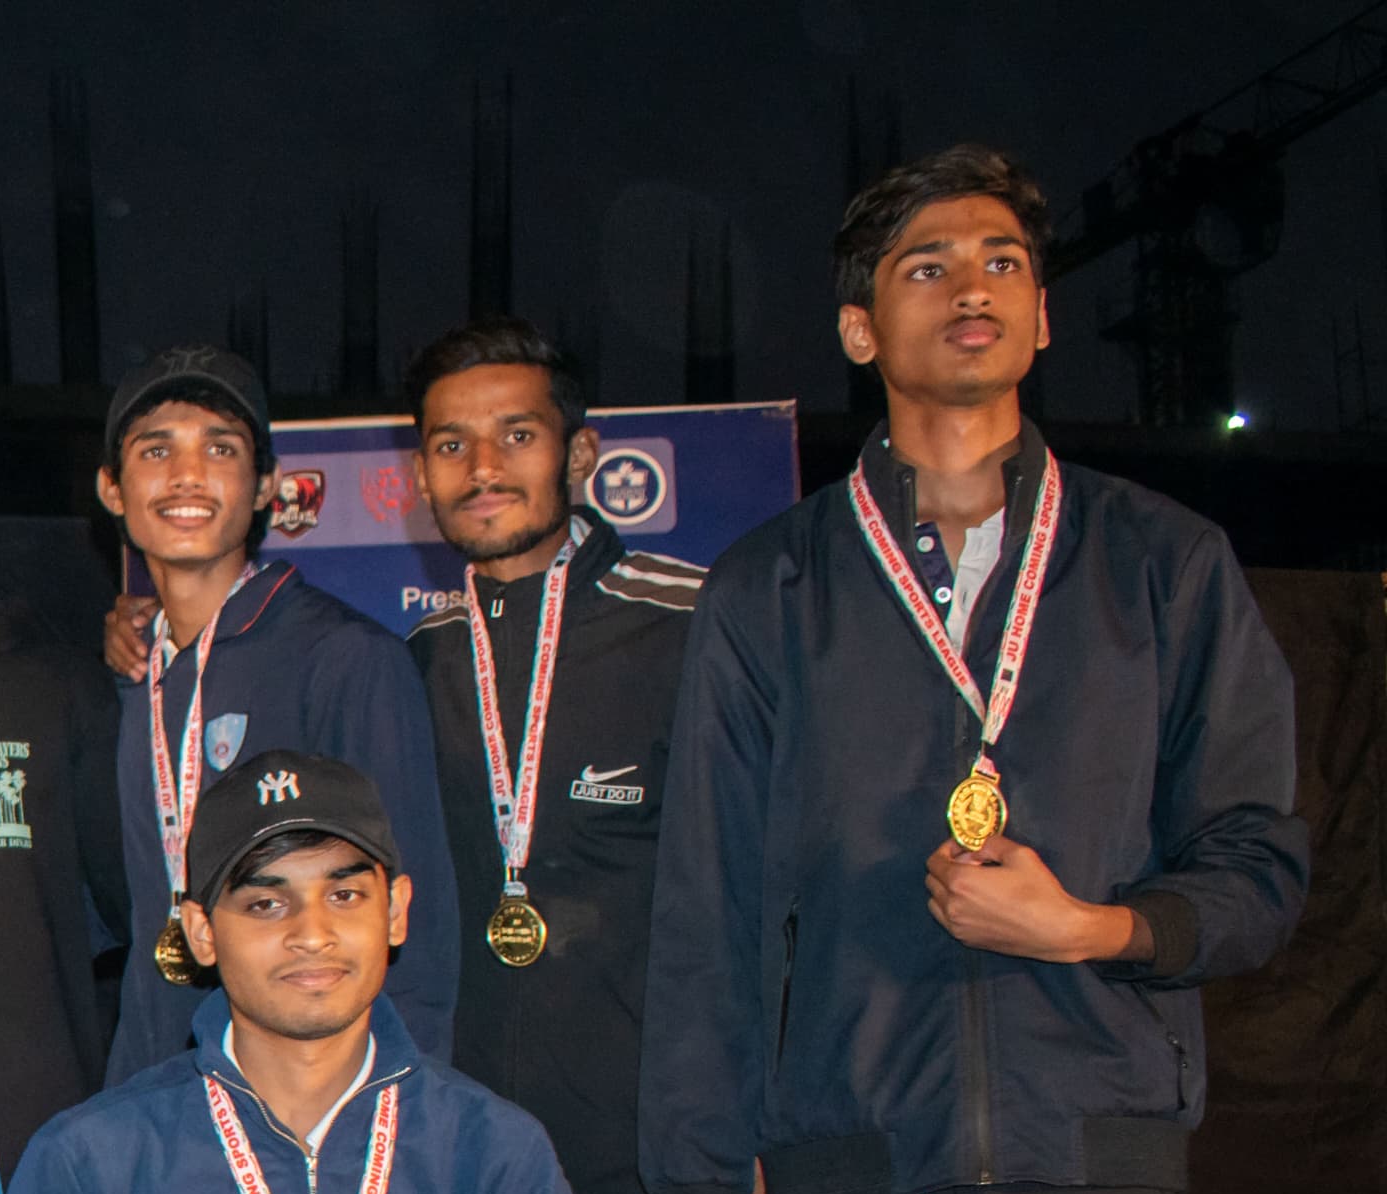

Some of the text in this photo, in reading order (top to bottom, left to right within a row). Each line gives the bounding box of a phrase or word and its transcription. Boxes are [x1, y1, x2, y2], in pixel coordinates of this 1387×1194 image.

[1021, 529, 1048, 591] COMING
[867, 518, 904, 575] COMING
[897, 573, 936, 630] SPORTS
[929, 628, 969, 687] LEAGUE
[1010, 591, 1032, 638] HOME
[470, 620, 488, 673] SPORTS
[1005, 640, 1019, 663] JU
[479, 675, 495, 731] COMING
[516, 573, 560, 825] JU HOME COMING SPORTS LEAGUE
[155, 752, 168, 789] HOME
[487, 733, 503, 774] HOME
[160, 791, 172, 810] JU
[494, 778, 506, 797] JU
[575, 783, 639, 800] JUST DO IT
[214, 1106, 248, 1170] SPORTS
